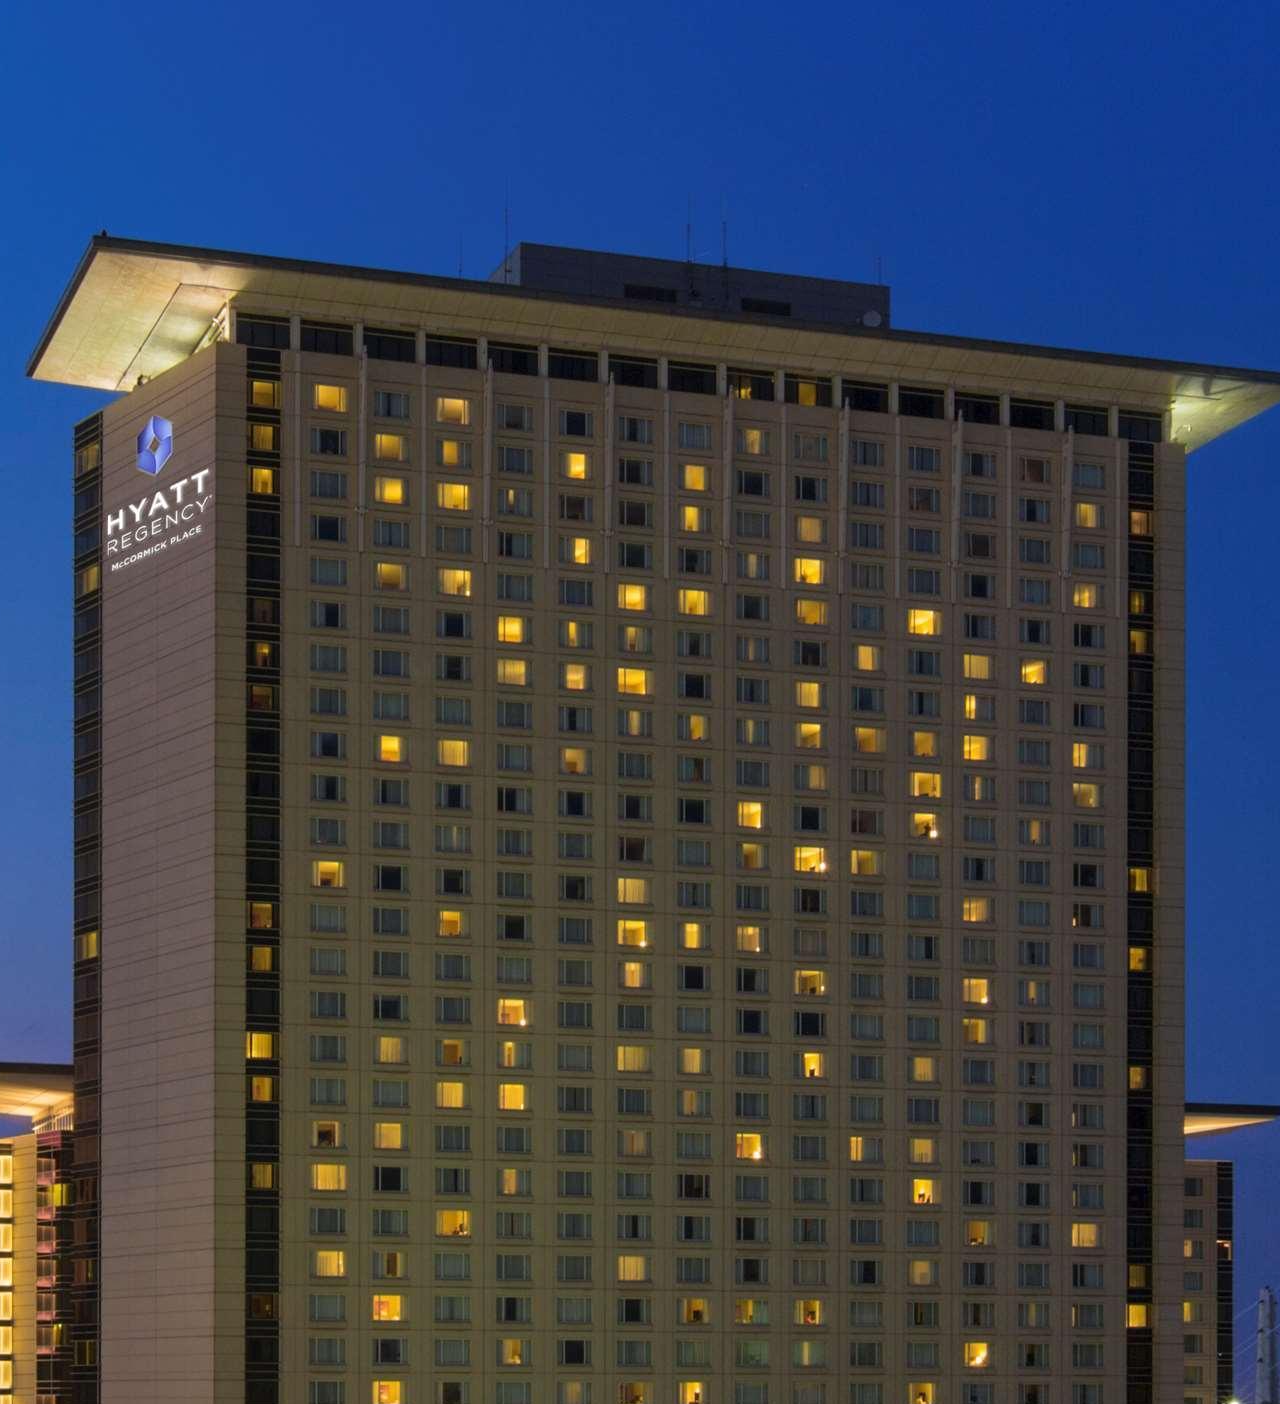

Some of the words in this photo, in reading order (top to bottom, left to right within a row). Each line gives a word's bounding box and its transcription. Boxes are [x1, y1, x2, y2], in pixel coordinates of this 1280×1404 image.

[106, 497, 210, 557] REGENCY
[107, 468, 209, 536] HYATT
[111, 540, 167, 572] McCORMICK
[170, 525, 202, 545] PLACE
